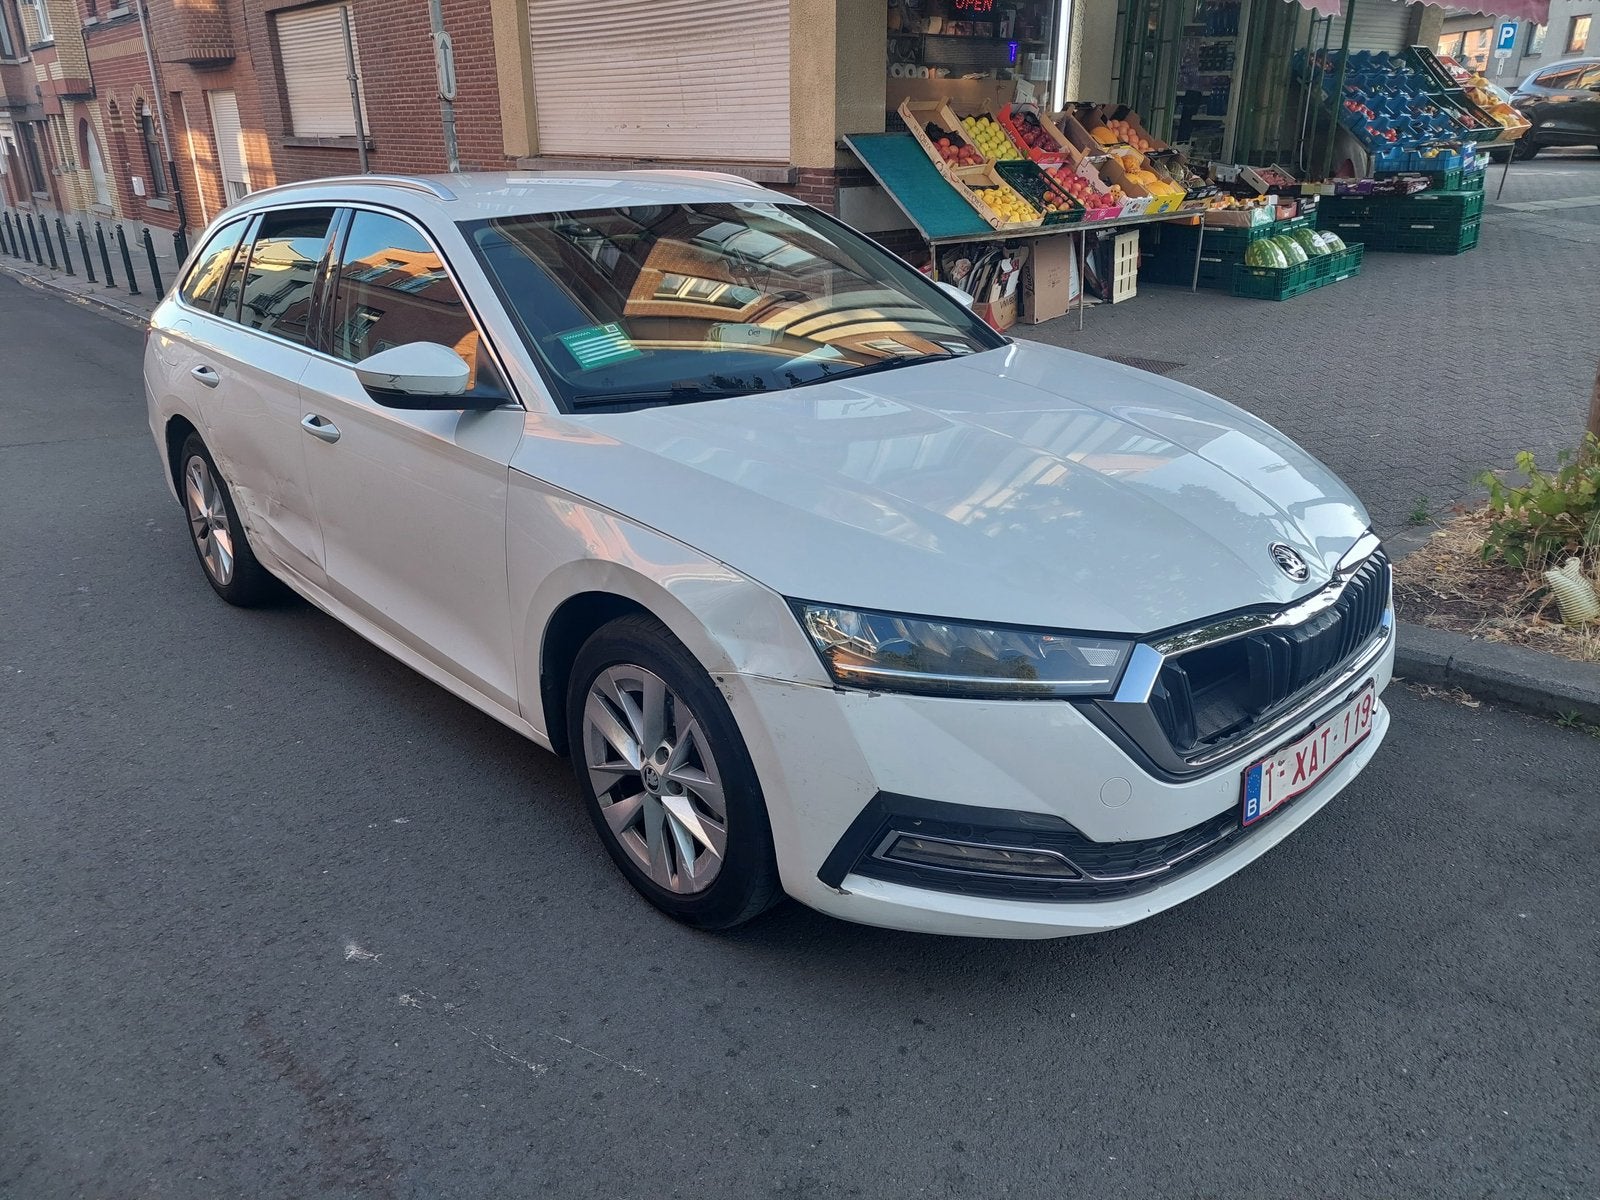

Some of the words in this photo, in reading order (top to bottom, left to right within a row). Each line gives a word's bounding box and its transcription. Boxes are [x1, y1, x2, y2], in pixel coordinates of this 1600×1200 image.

[955, 0, 993, 12] OPEN
[1500, 26, 1514, 46] P
[1247, 798, 1257, 817] B
